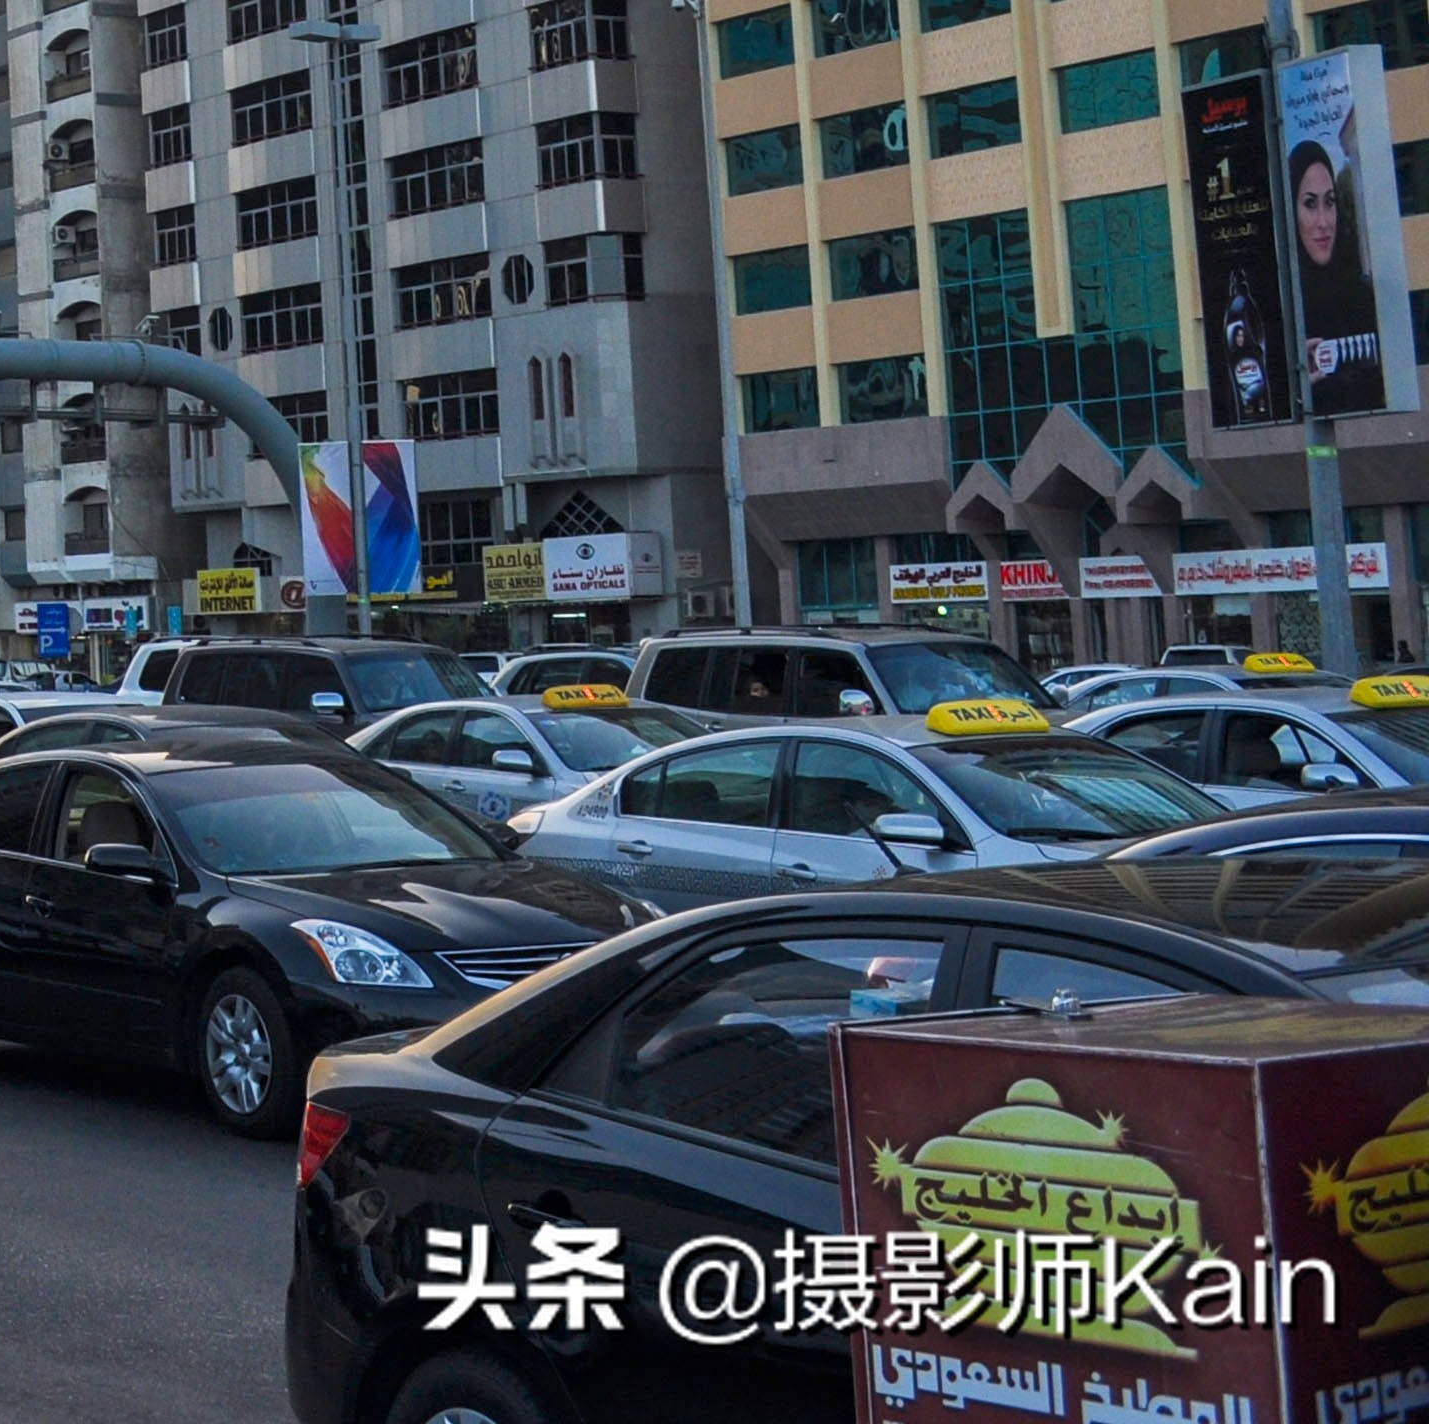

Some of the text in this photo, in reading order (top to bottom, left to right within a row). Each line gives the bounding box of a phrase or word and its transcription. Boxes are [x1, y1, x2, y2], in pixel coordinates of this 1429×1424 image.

[553, 579, 626, 592] SANA OPTICALS
[201, 597, 255, 612] INTERNET
[42, 635, 53, 653] P
[949, 707, 992, 722] TAXI
[915, 1172, 1049, 1221] الخليج
[872, 1343, 1065, 1417] السعودي
